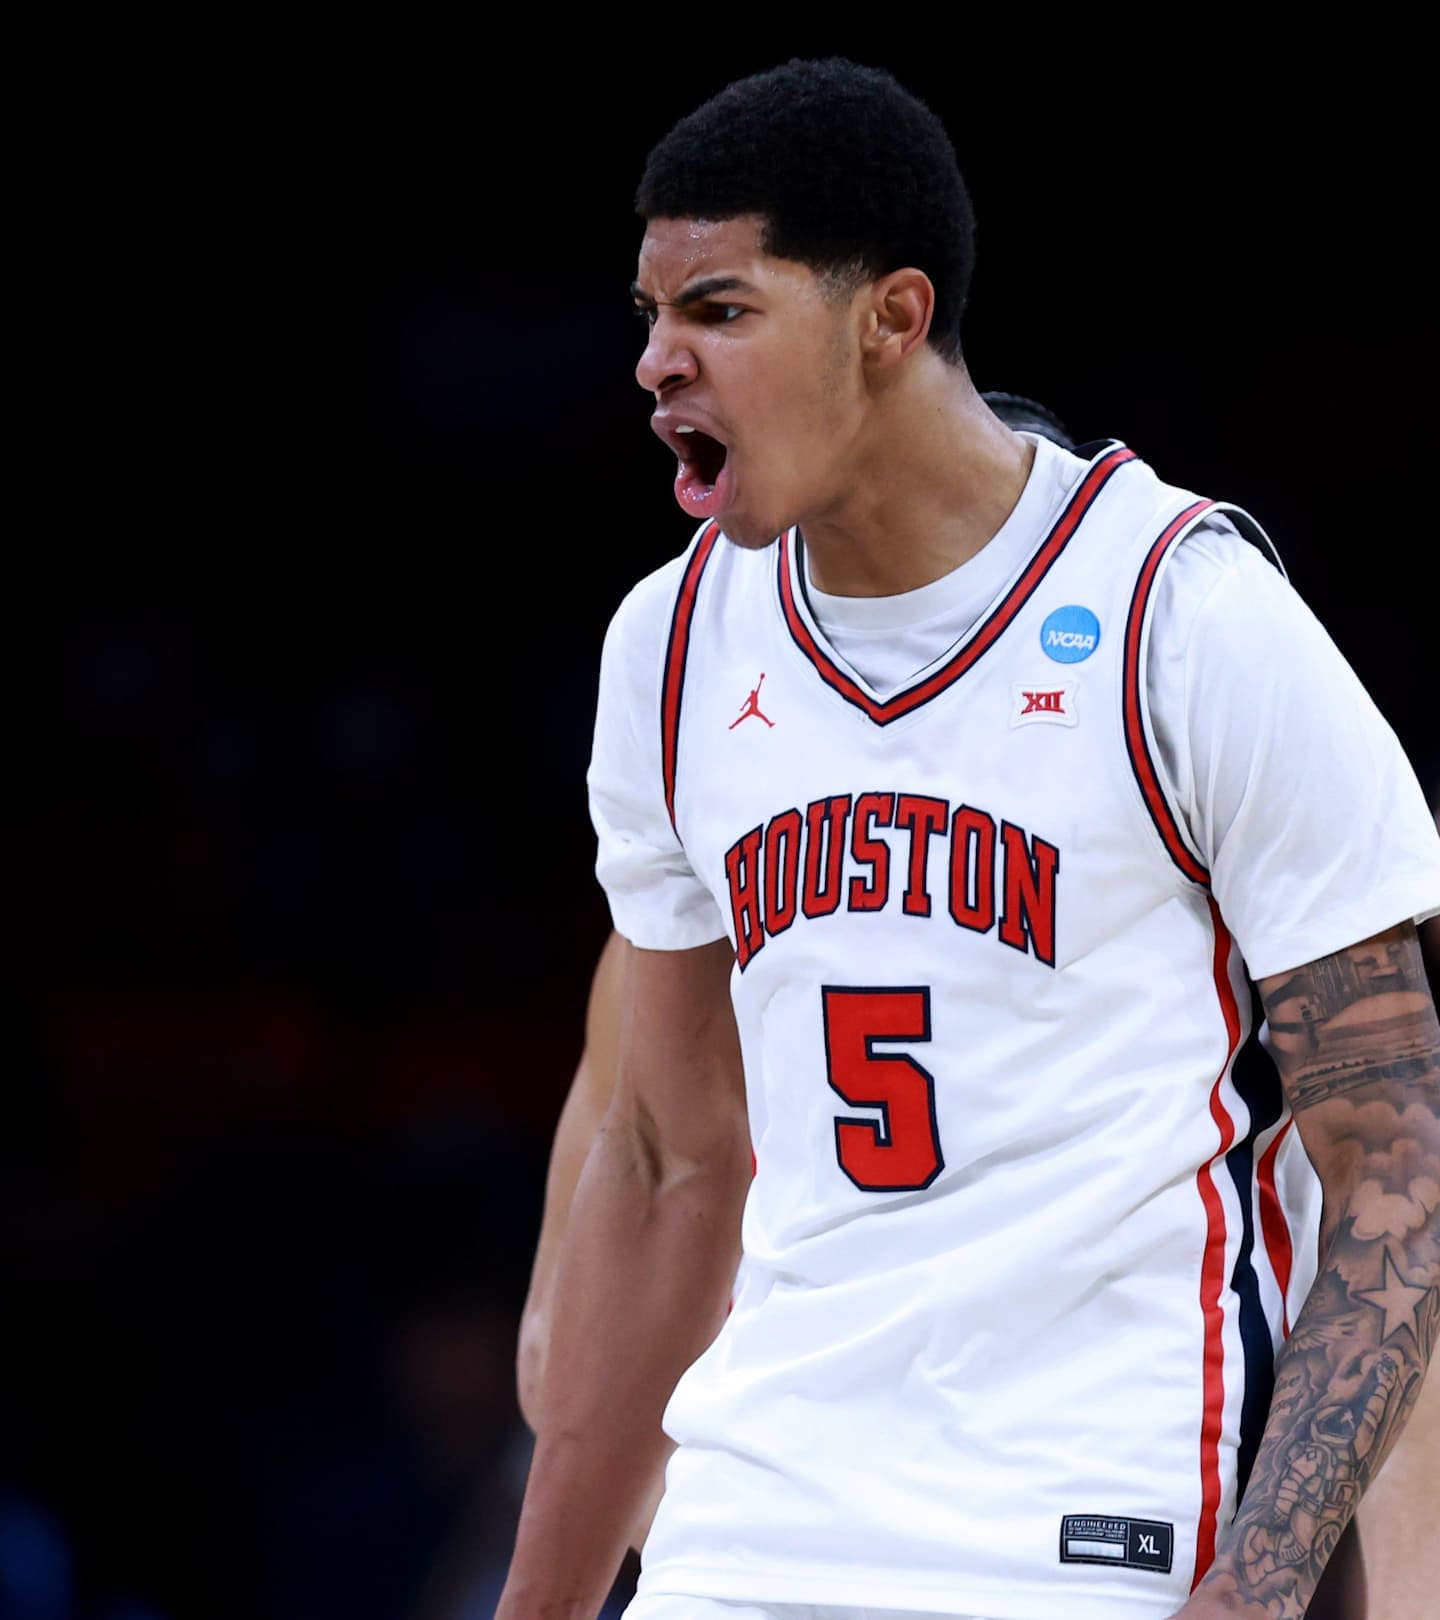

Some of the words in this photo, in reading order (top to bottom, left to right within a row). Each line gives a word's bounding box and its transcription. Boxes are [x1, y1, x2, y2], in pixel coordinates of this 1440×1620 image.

[1046, 630, 1095, 650] NCAA
[1021, 689, 1066, 715] XII
[725, 792, 1059, 973] HOUSTON
[821, 985, 945, 1193] 5
[1068, 1520, 1126, 1530] ENGINEERED
[1138, 1533, 1160, 1555] XL
